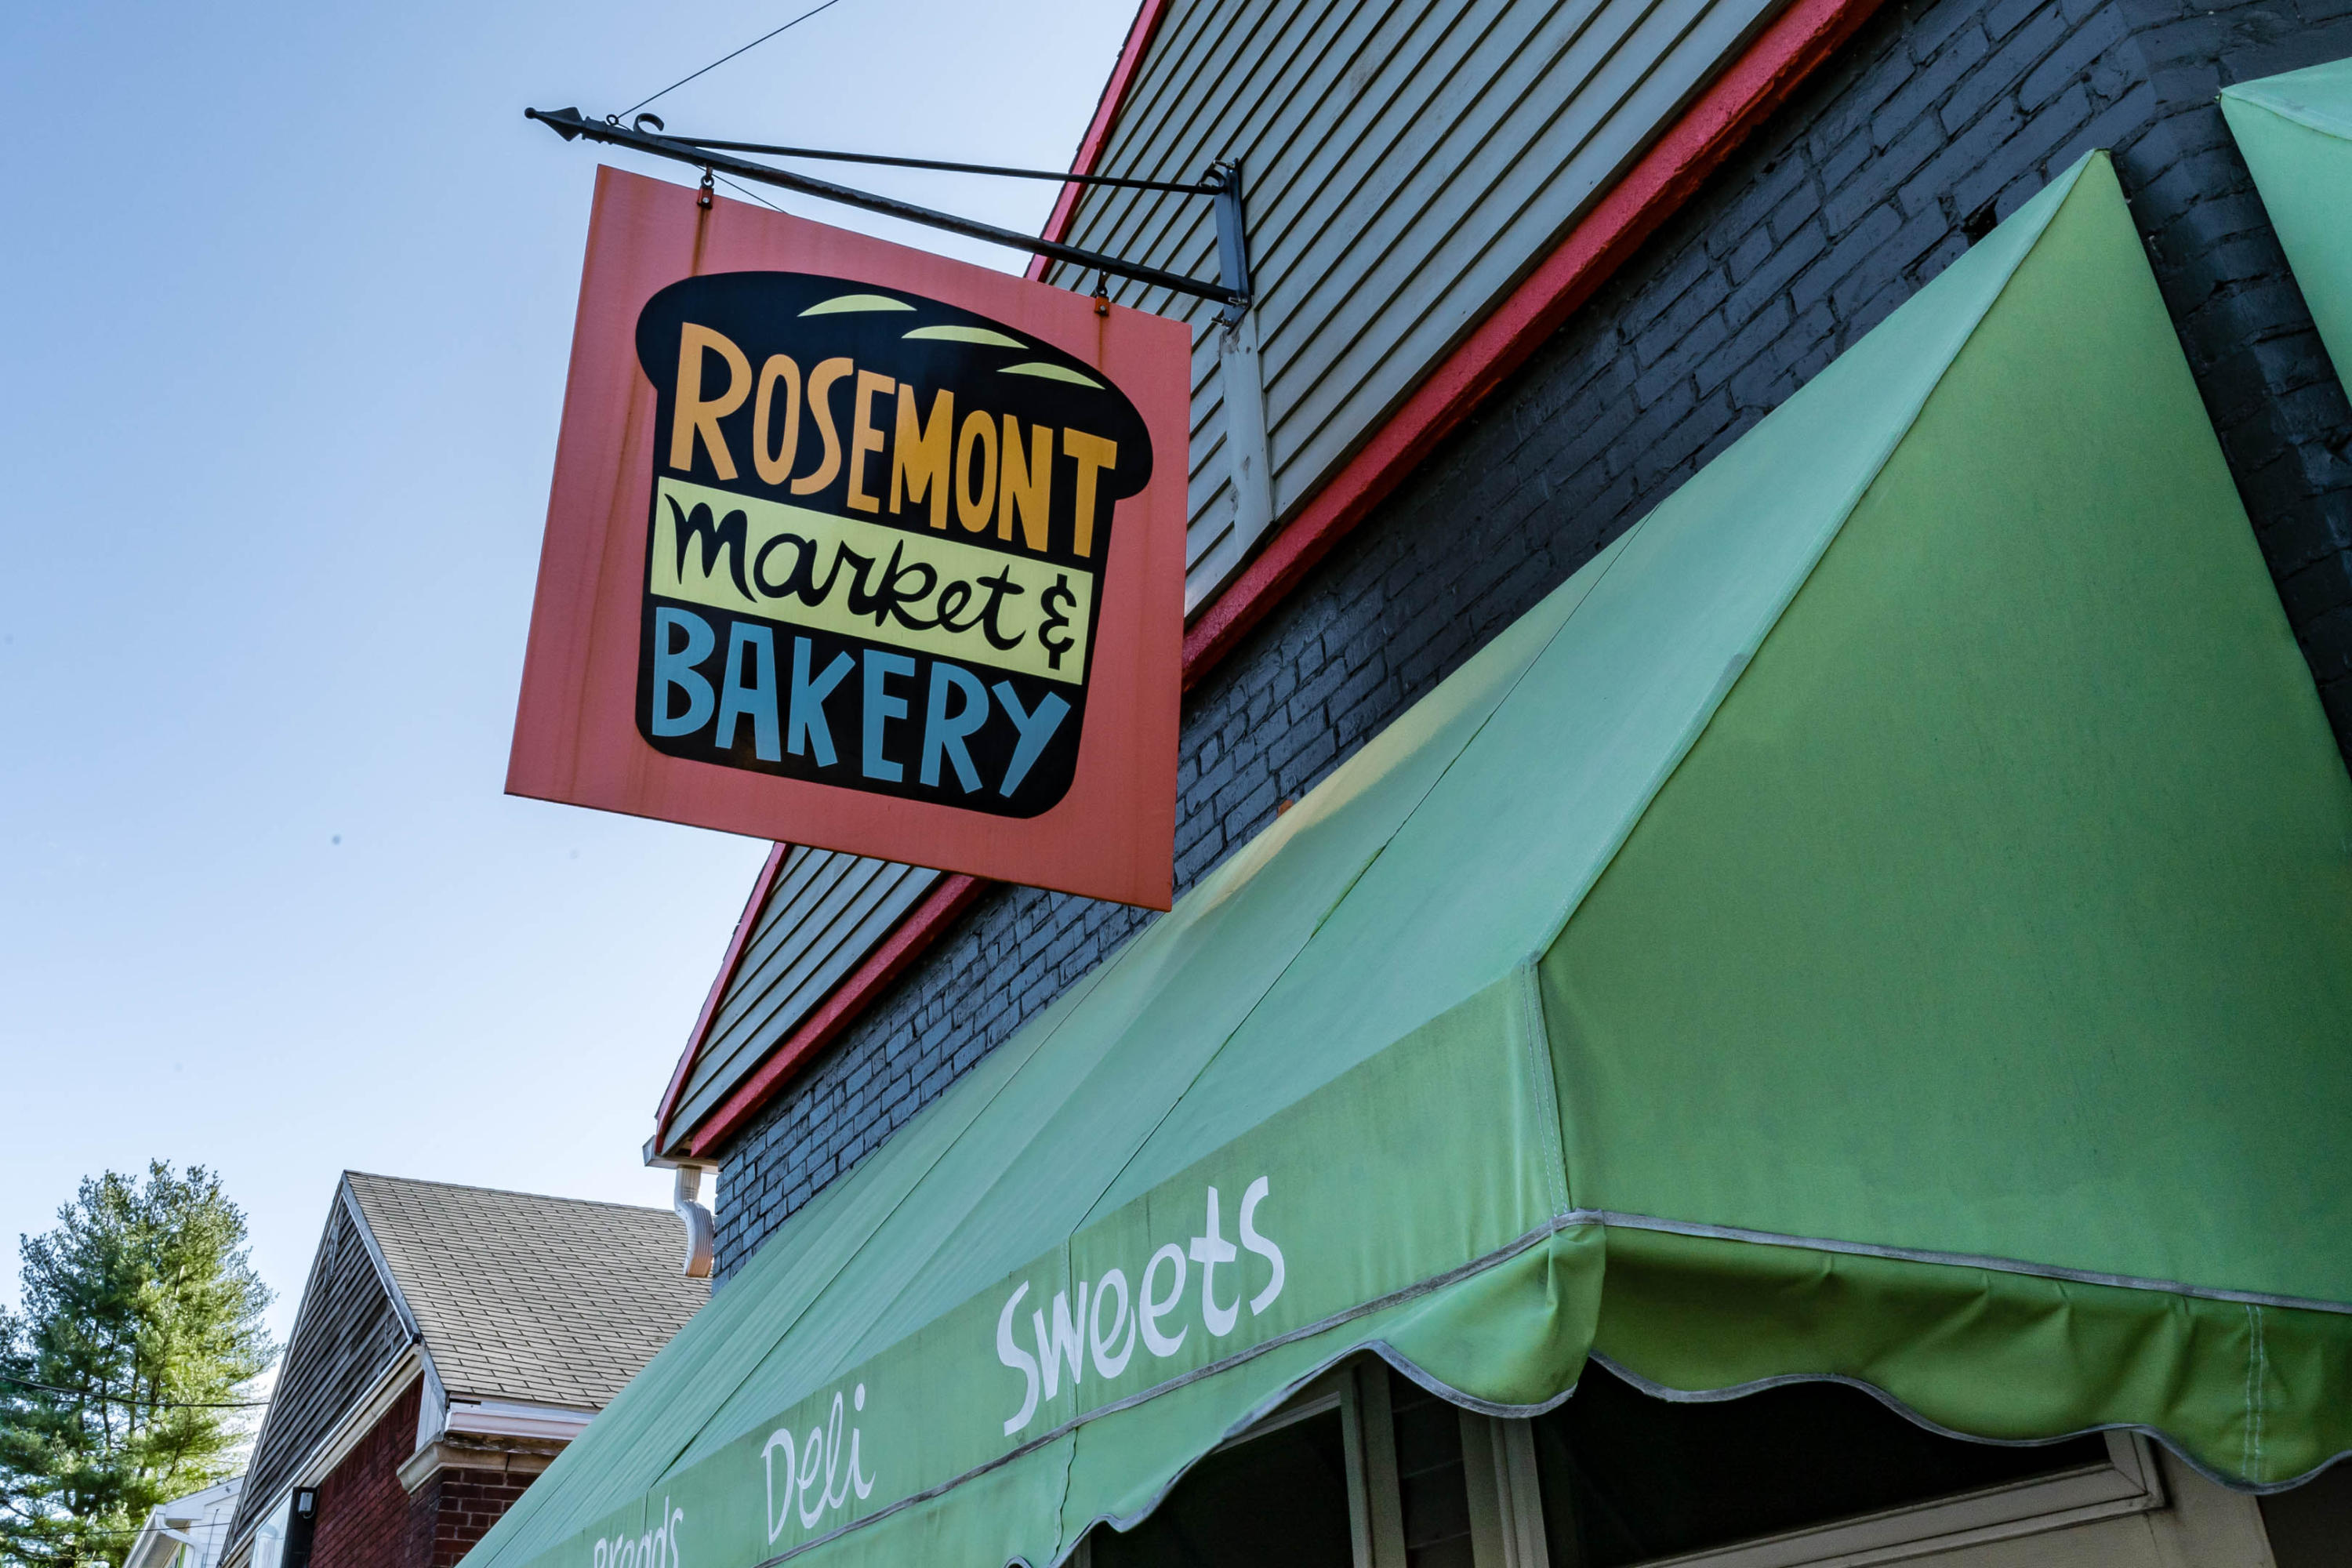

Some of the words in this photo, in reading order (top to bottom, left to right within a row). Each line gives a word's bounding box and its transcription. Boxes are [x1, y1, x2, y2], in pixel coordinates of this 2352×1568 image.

[670, 322, 1117, 557] ROSEMONT
[652, 606, 1071, 798] BAKERY
[1038, 574, 1077, 670] &
[760, 1383, 876, 1545] Deli
[996, 1176, 1285, 1436] Sweets
